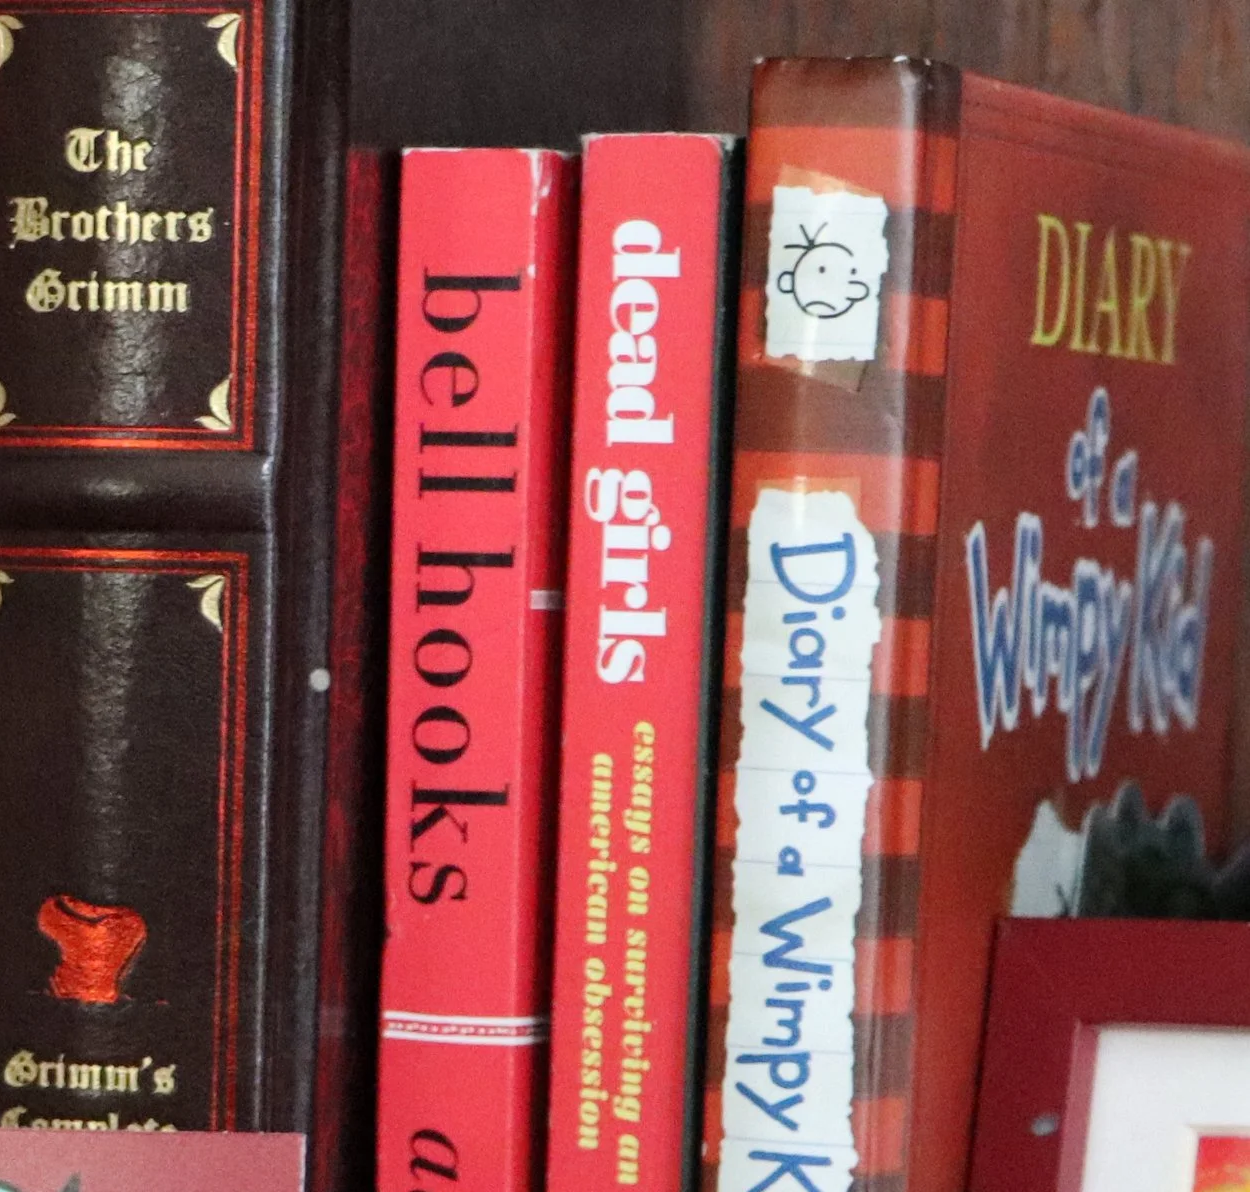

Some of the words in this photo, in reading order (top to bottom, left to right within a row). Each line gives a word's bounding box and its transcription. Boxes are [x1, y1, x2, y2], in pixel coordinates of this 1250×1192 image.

[10, 197, 213, 249] Brothers
[67, 128, 152, 175] The
[27, 268, 190, 313] Grimm
[607, 220, 680, 446] dead
[1030, 213, 1191, 364] DIARY
[419, 268, 521, 497] bell
[1066, 387, 1110, 528] of
[1111, 449, 1139, 528] a
[585, 468, 671, 683] girls
[759, 533, 856, 751] Diary
[965, 511, 1132, 781] Wimpy
[1130, 500, 1213, 734] Kid
[409, 544, 514, 905] hooks
[624, 719, 654, 855] essays
[779, 770, 836, 828] of
[586, 752, 615, 945] american
[628, 867, 649, 914] on
[777, 846, 804, 876] a
[4, 1051, 176, 1095] Grimm's
[578, 957, 608, 1149] obsession
[613, 929, 651, 1122] surviving
[735, 897, 832, 1131] Wimpy
[618, 1134, 639, 1184] an
